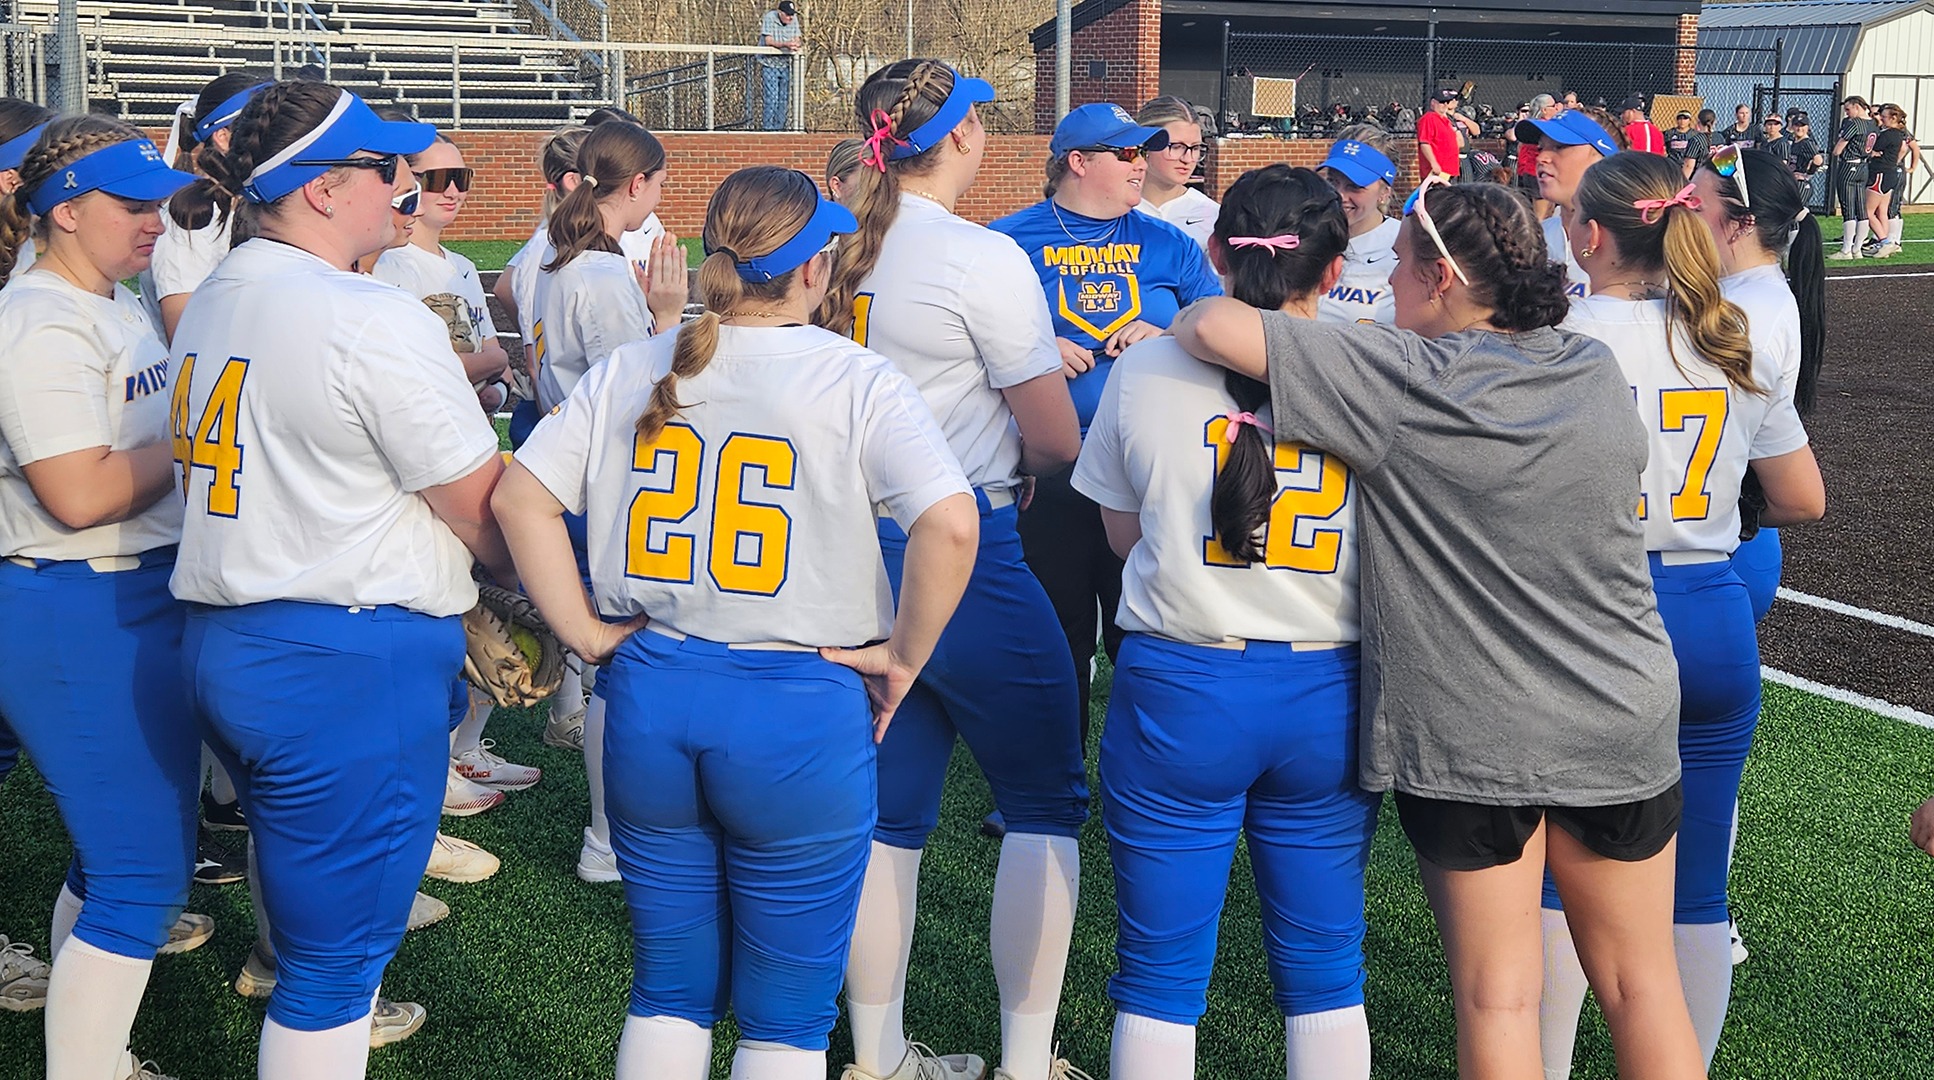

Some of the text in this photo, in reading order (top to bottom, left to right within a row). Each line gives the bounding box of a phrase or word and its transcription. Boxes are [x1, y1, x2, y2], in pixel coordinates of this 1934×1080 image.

[1043, 242, 1141, 267] MIDWAY
[1058, 262, 1134, 276] SOFTBALL
[1079, 291, 1120, 301] MIDWAY
[170, 352, 251, 519] 44
[1203, 414, 1350, 574] 12
[624, 421, 798, 598] 26
[456, 764, 475, 772] NEW
[459, 770, 492, 778] ALANCE
